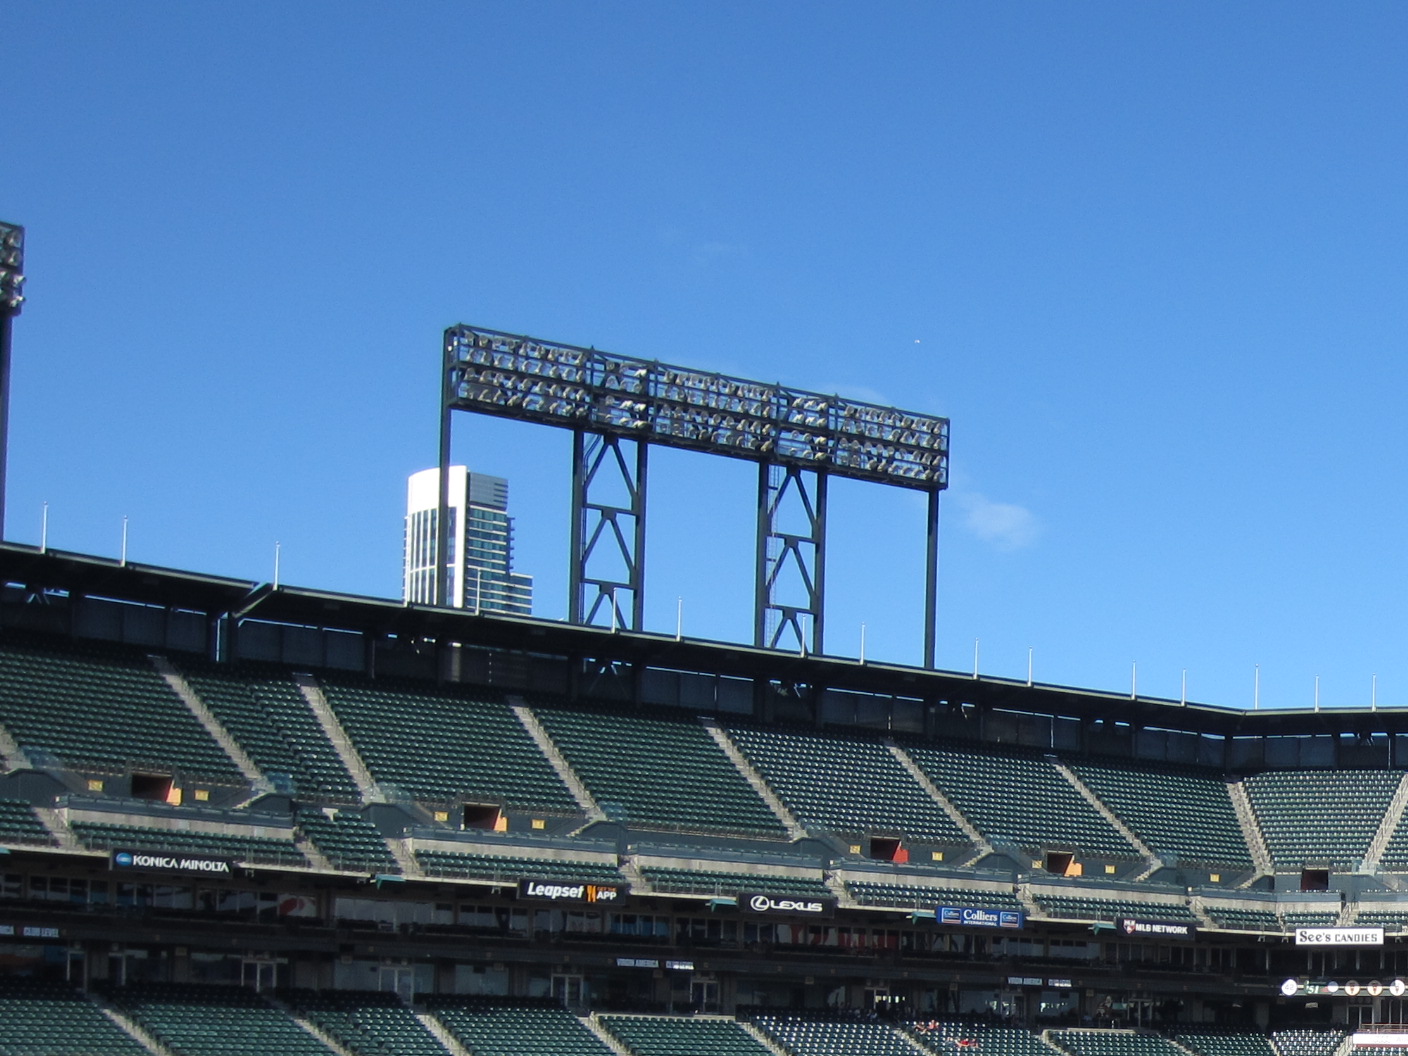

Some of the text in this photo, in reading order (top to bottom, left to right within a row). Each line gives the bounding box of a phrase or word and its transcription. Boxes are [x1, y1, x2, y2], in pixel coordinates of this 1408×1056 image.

[133, 855, 230, 872] KONICA MINOLTA
[527, 881, 585, 899] Leapset
[596, 891, 617, 900] APP
[770, 899, 823, 912] LEXUS
[963, 909, 998, 921] Colliers
[1136, 923, 1188, 935] MLB NETWORK
[1299, 930, 1378, 943] See's CANDIES
